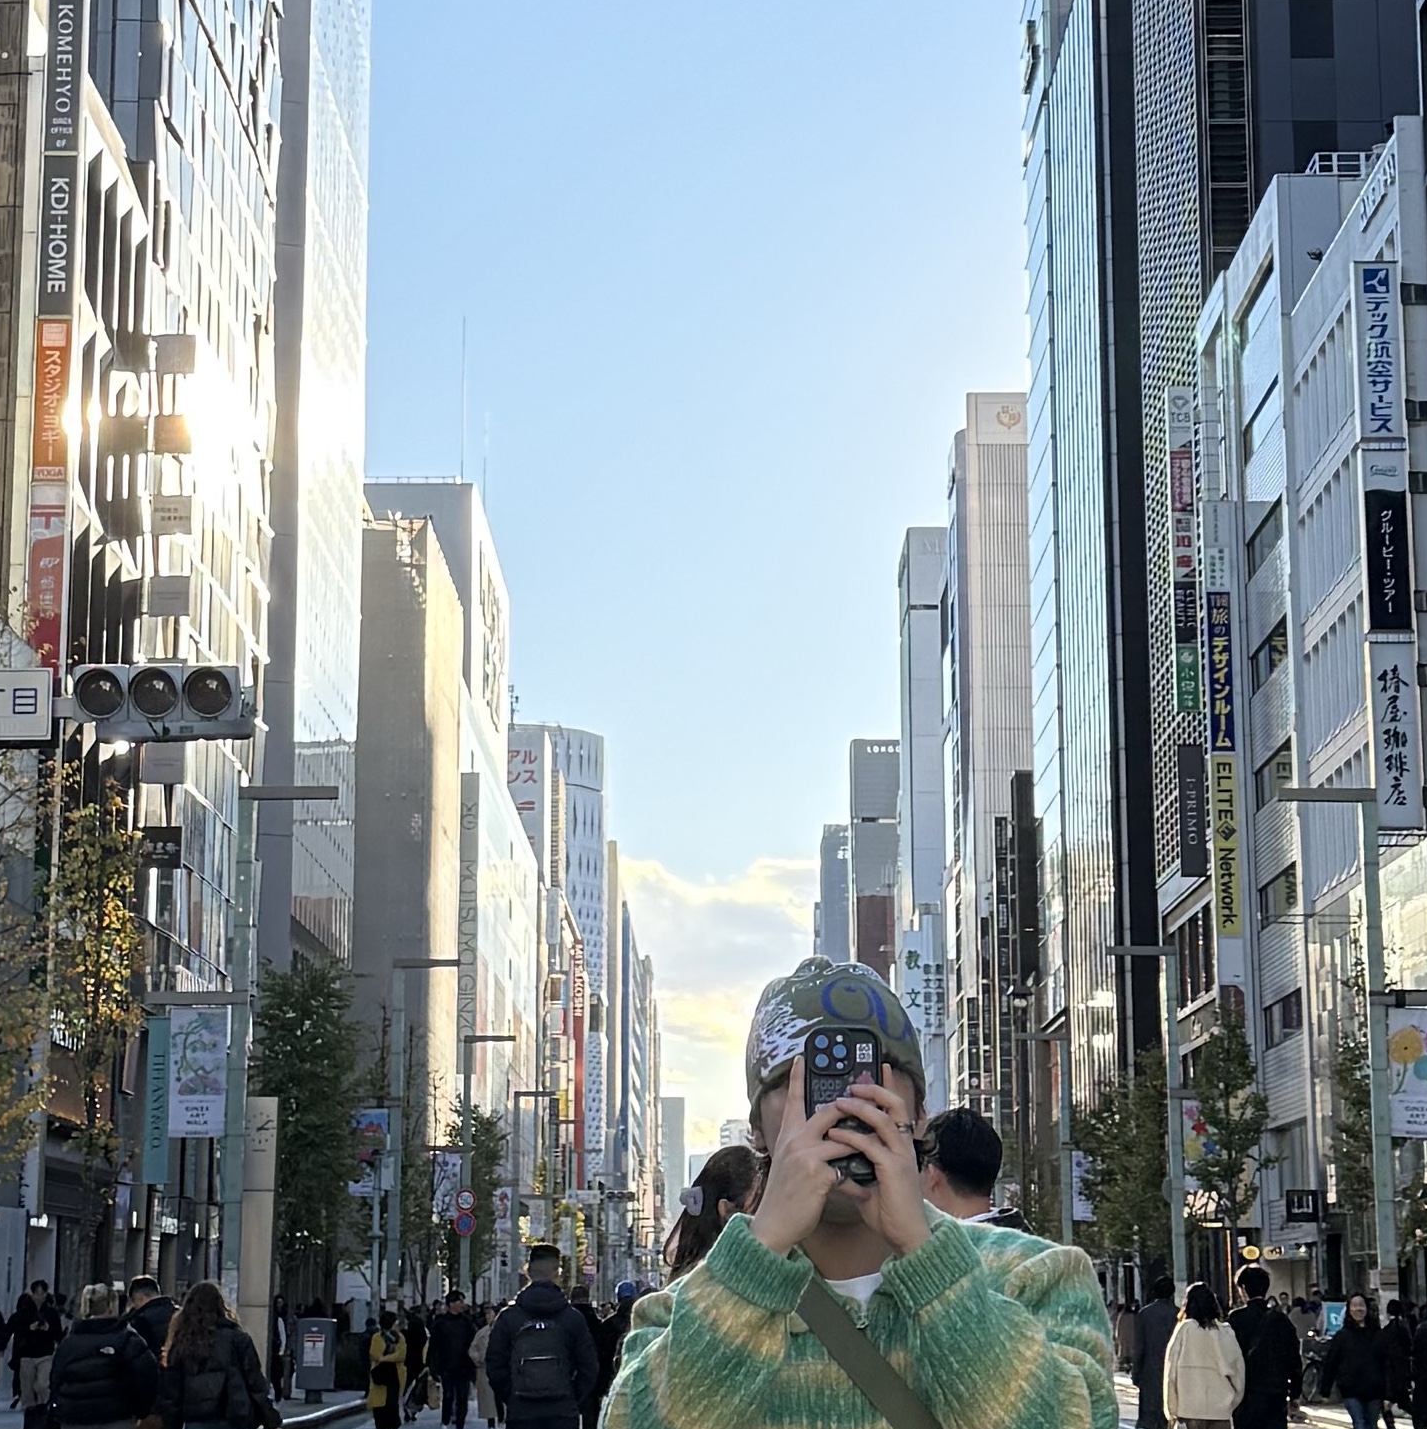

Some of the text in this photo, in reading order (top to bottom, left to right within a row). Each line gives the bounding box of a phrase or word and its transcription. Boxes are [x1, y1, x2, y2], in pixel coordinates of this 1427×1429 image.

[55, 4, 74, 113] KOMEHYO
[47, 177, 70, 293] KDI-HOME
[1216, 762, 1234, 821] ELITE
